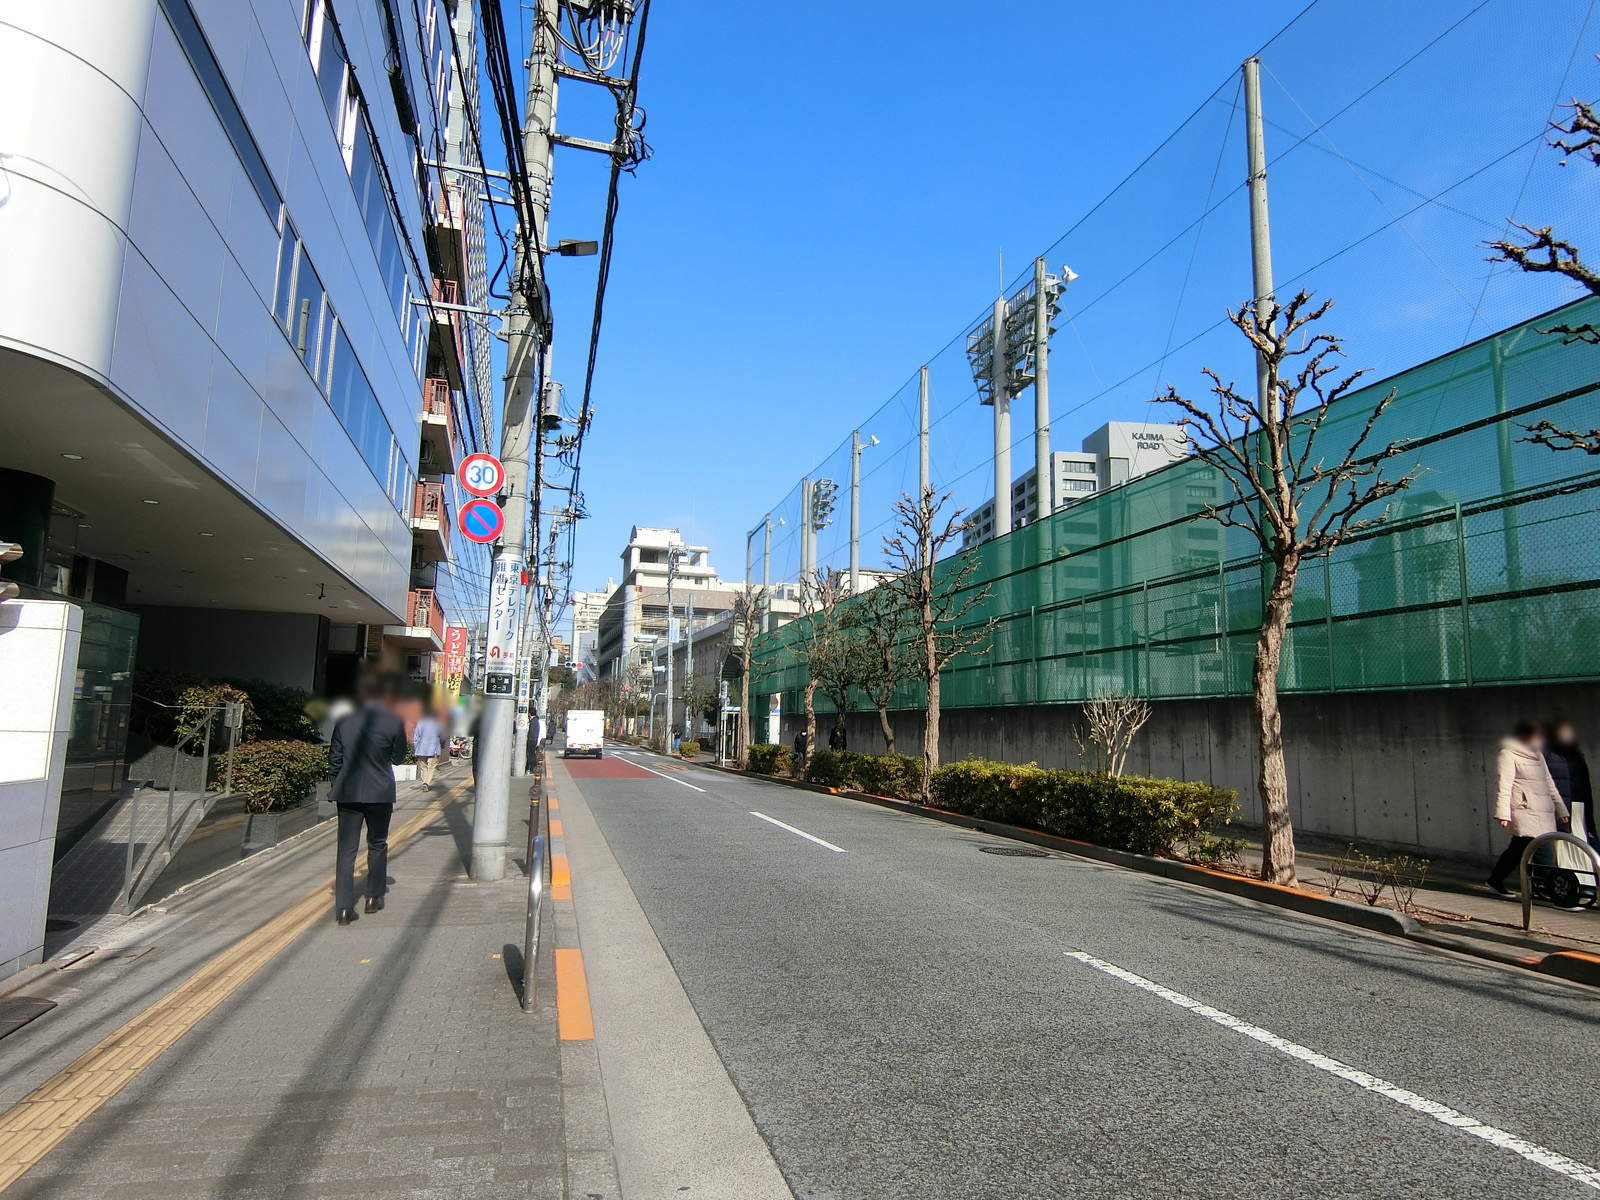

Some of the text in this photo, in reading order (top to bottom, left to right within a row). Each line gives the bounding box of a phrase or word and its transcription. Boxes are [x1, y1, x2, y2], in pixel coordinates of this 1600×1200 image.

[1131, 432, 1164, 441] KAJIMA
[1137, 442, 1160, 450] ROAD
[470, 465, 495, 484] 30
[494, 561, 507, 630] 推進センター
[505, 562, 520, 640] 東京テレワーク
